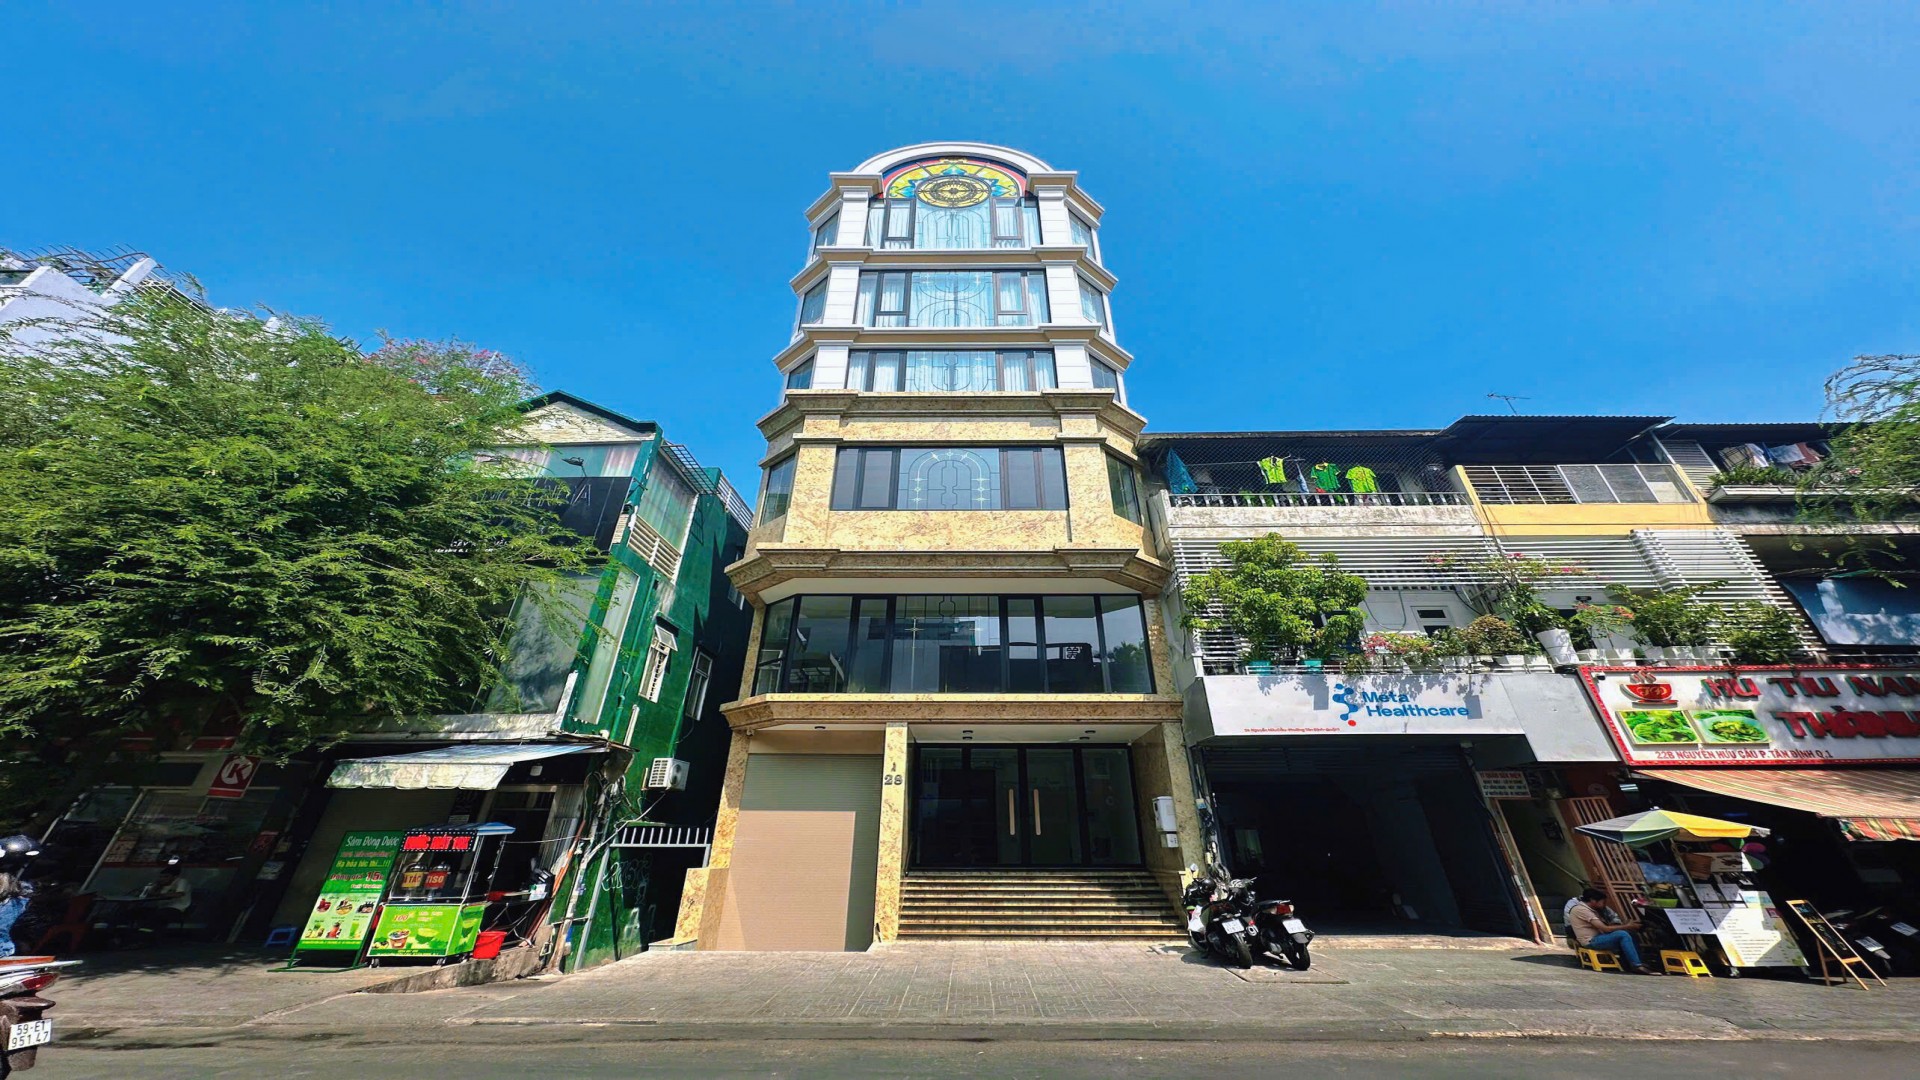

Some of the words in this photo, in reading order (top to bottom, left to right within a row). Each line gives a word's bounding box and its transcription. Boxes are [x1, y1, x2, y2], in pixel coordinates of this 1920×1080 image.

[1361, 691, 1410, 703] Meta
[1366, 704, 1470, 717] Healthcare
[884, 774, 903, 786] 28
[17, 1021, 45, 1035] 59-E1
